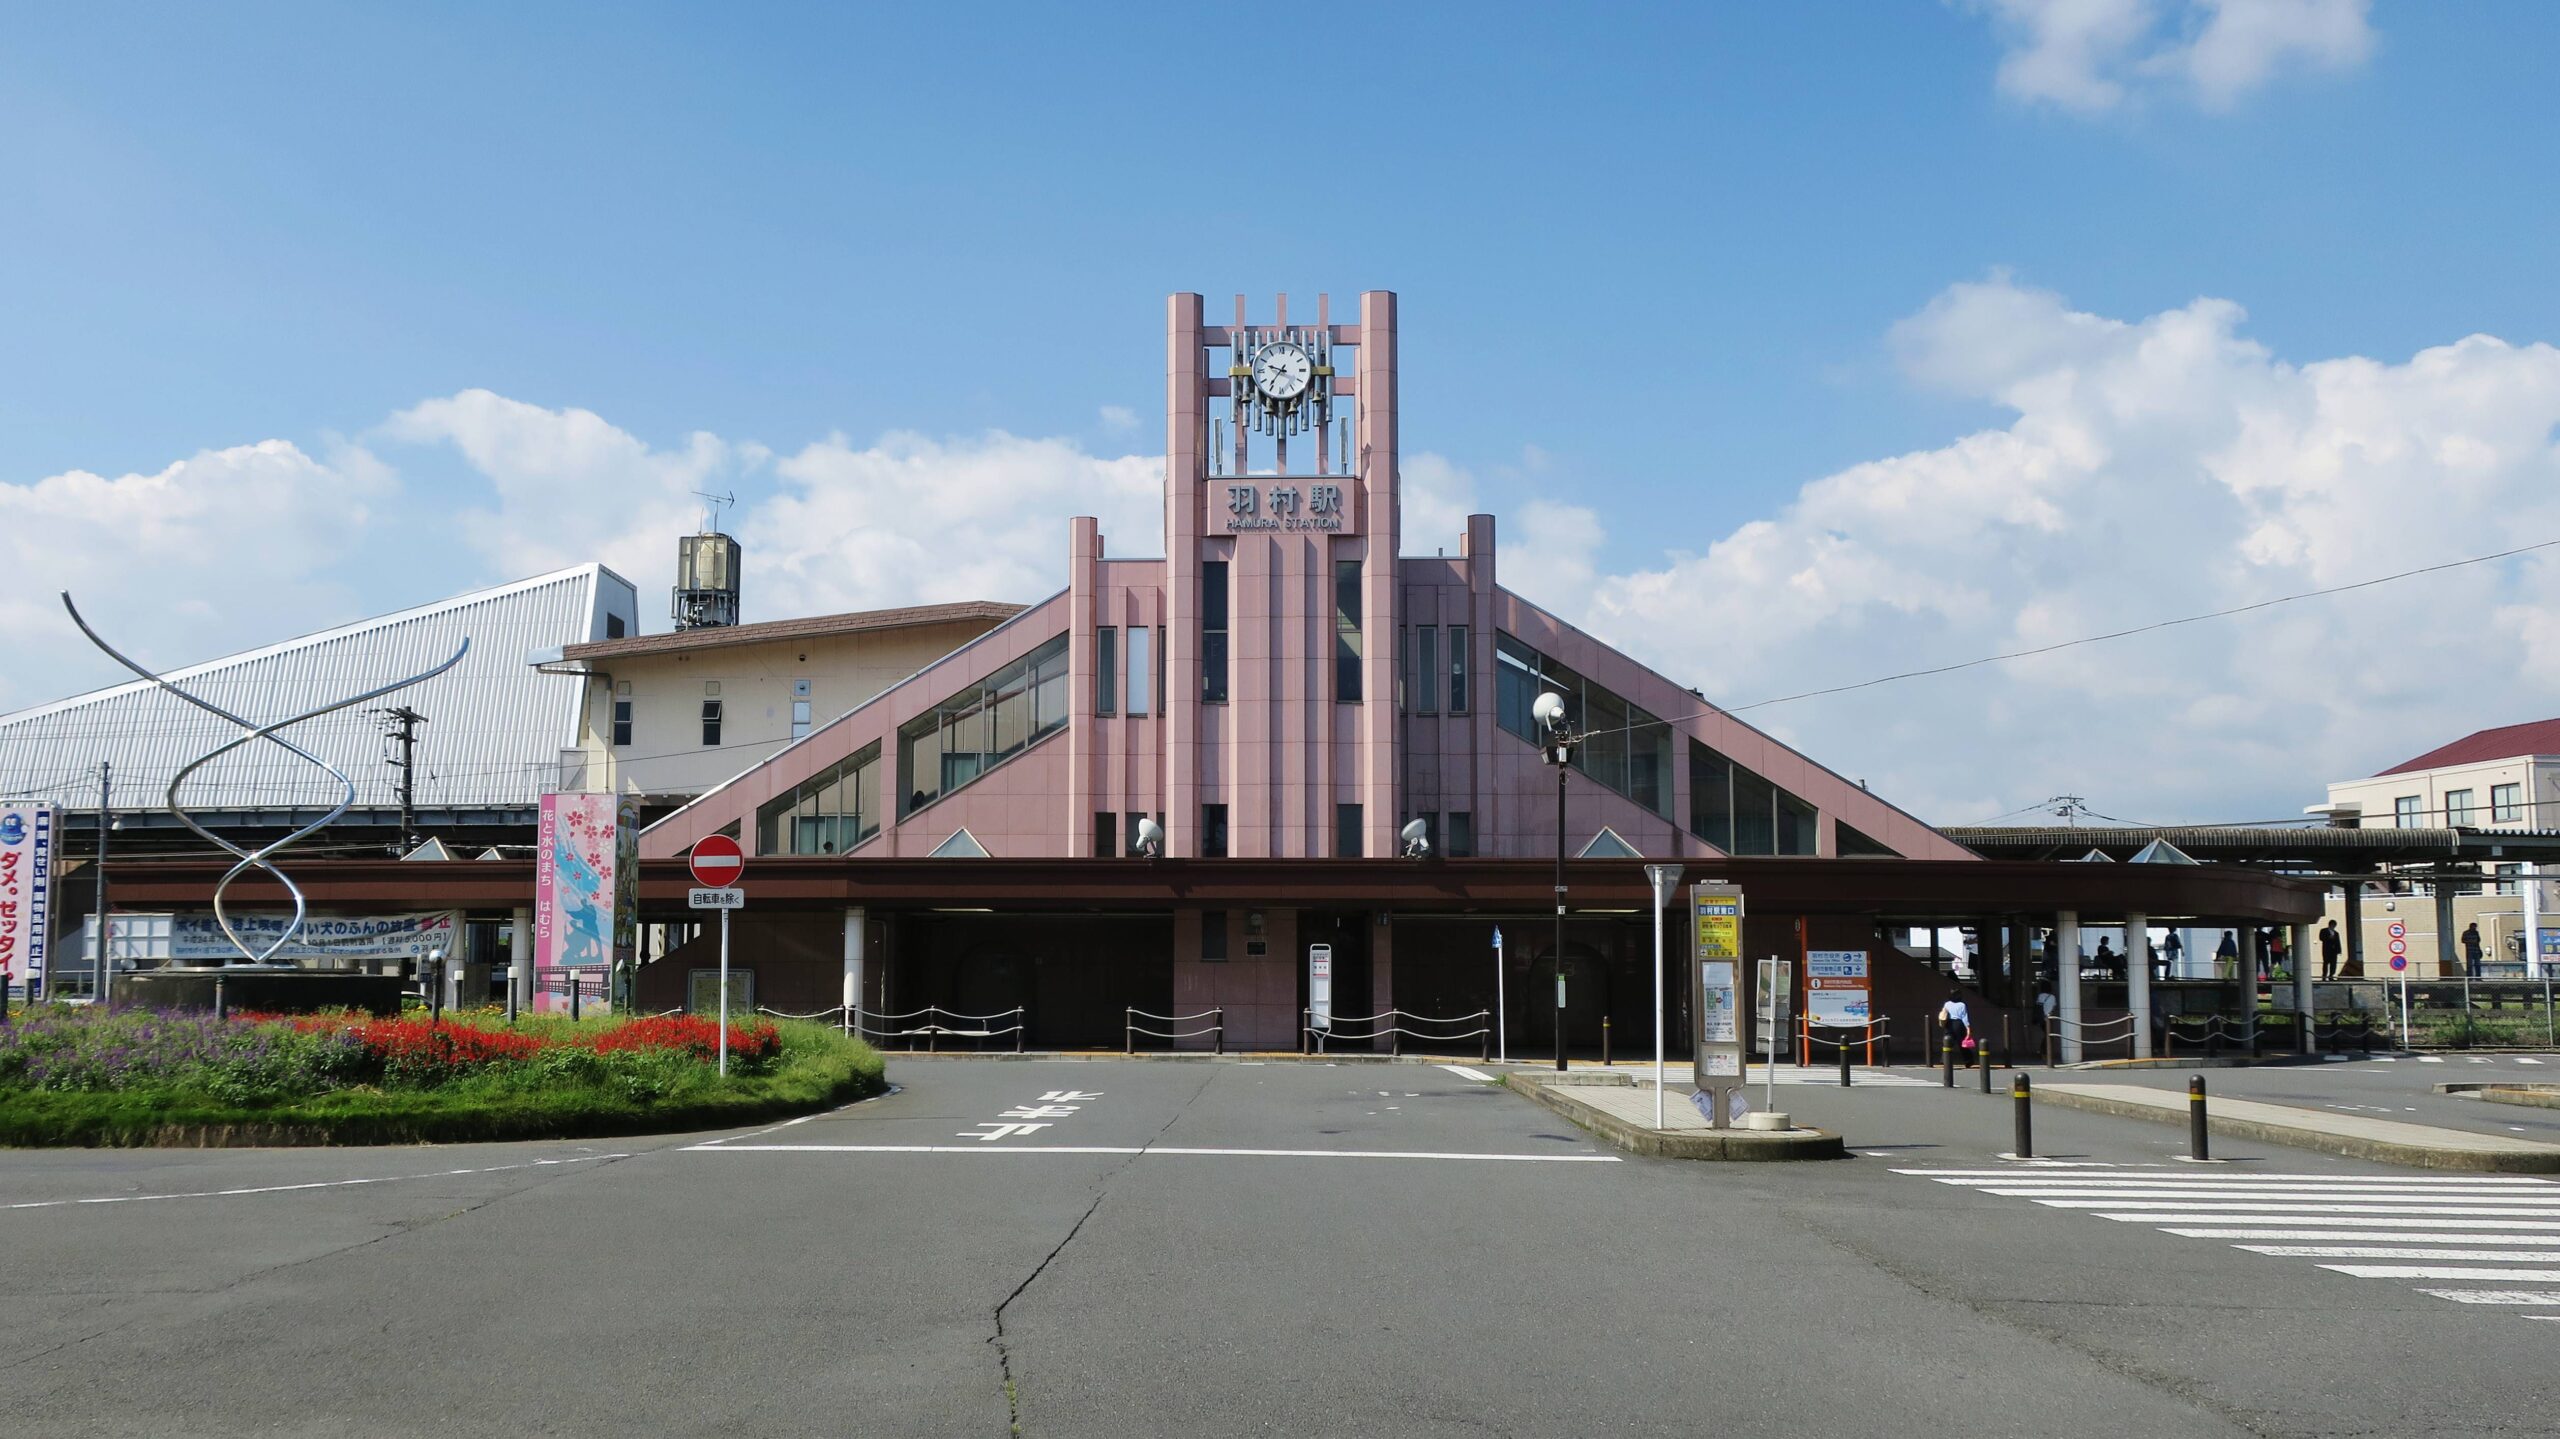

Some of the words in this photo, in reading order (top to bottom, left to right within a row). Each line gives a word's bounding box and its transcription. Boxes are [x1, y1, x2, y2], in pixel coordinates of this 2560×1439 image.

[1228, 485, 1339, 513] 羽村駅
[1227, 518, 1278, 528] HAMURA
[1286, 518, 1339, 528] STATION
[540, 810, 554, 885] 花と水のまち
[693, 893, 740, 905] 自転車を除く
[539, 901, 551, 938] はむら
